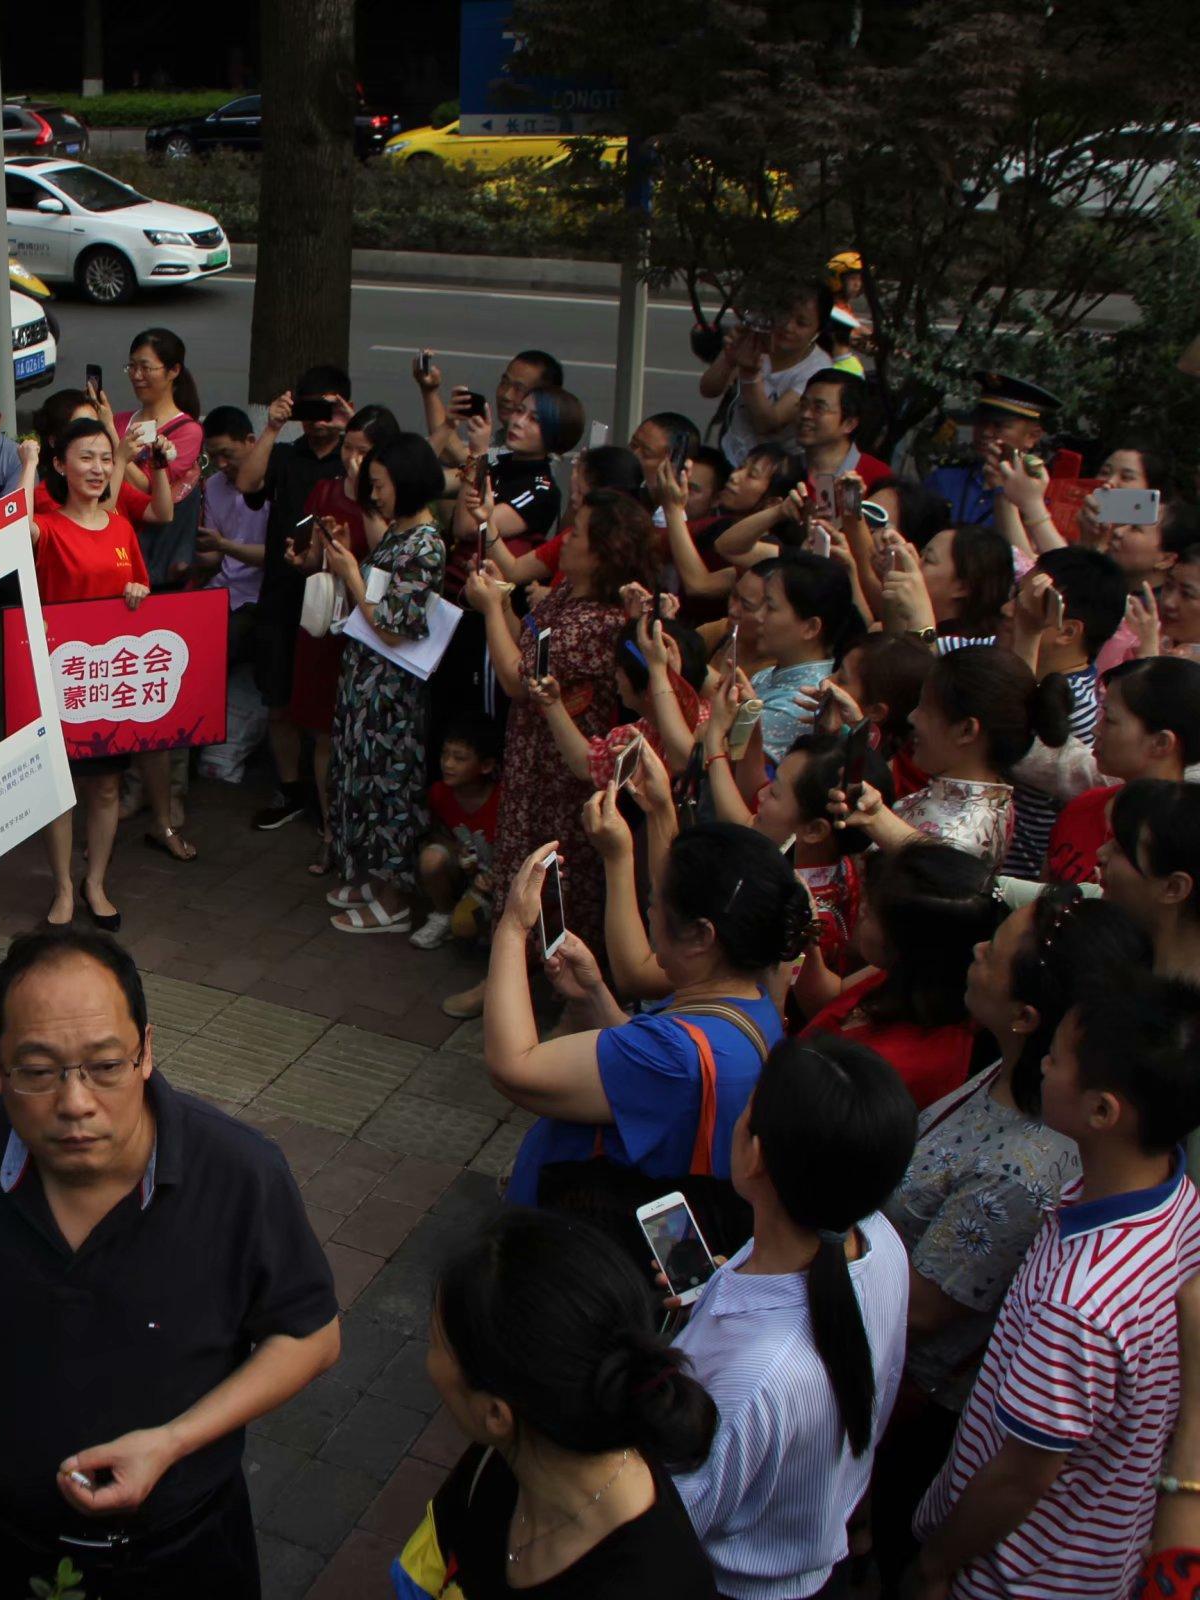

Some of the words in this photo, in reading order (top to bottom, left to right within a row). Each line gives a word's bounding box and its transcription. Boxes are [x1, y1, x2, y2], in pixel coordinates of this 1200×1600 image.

[115, 547, 129, 560] M
[61, 643, 173, 681] 考的全会
[63, 677, 169, 710] 蒙的全对
